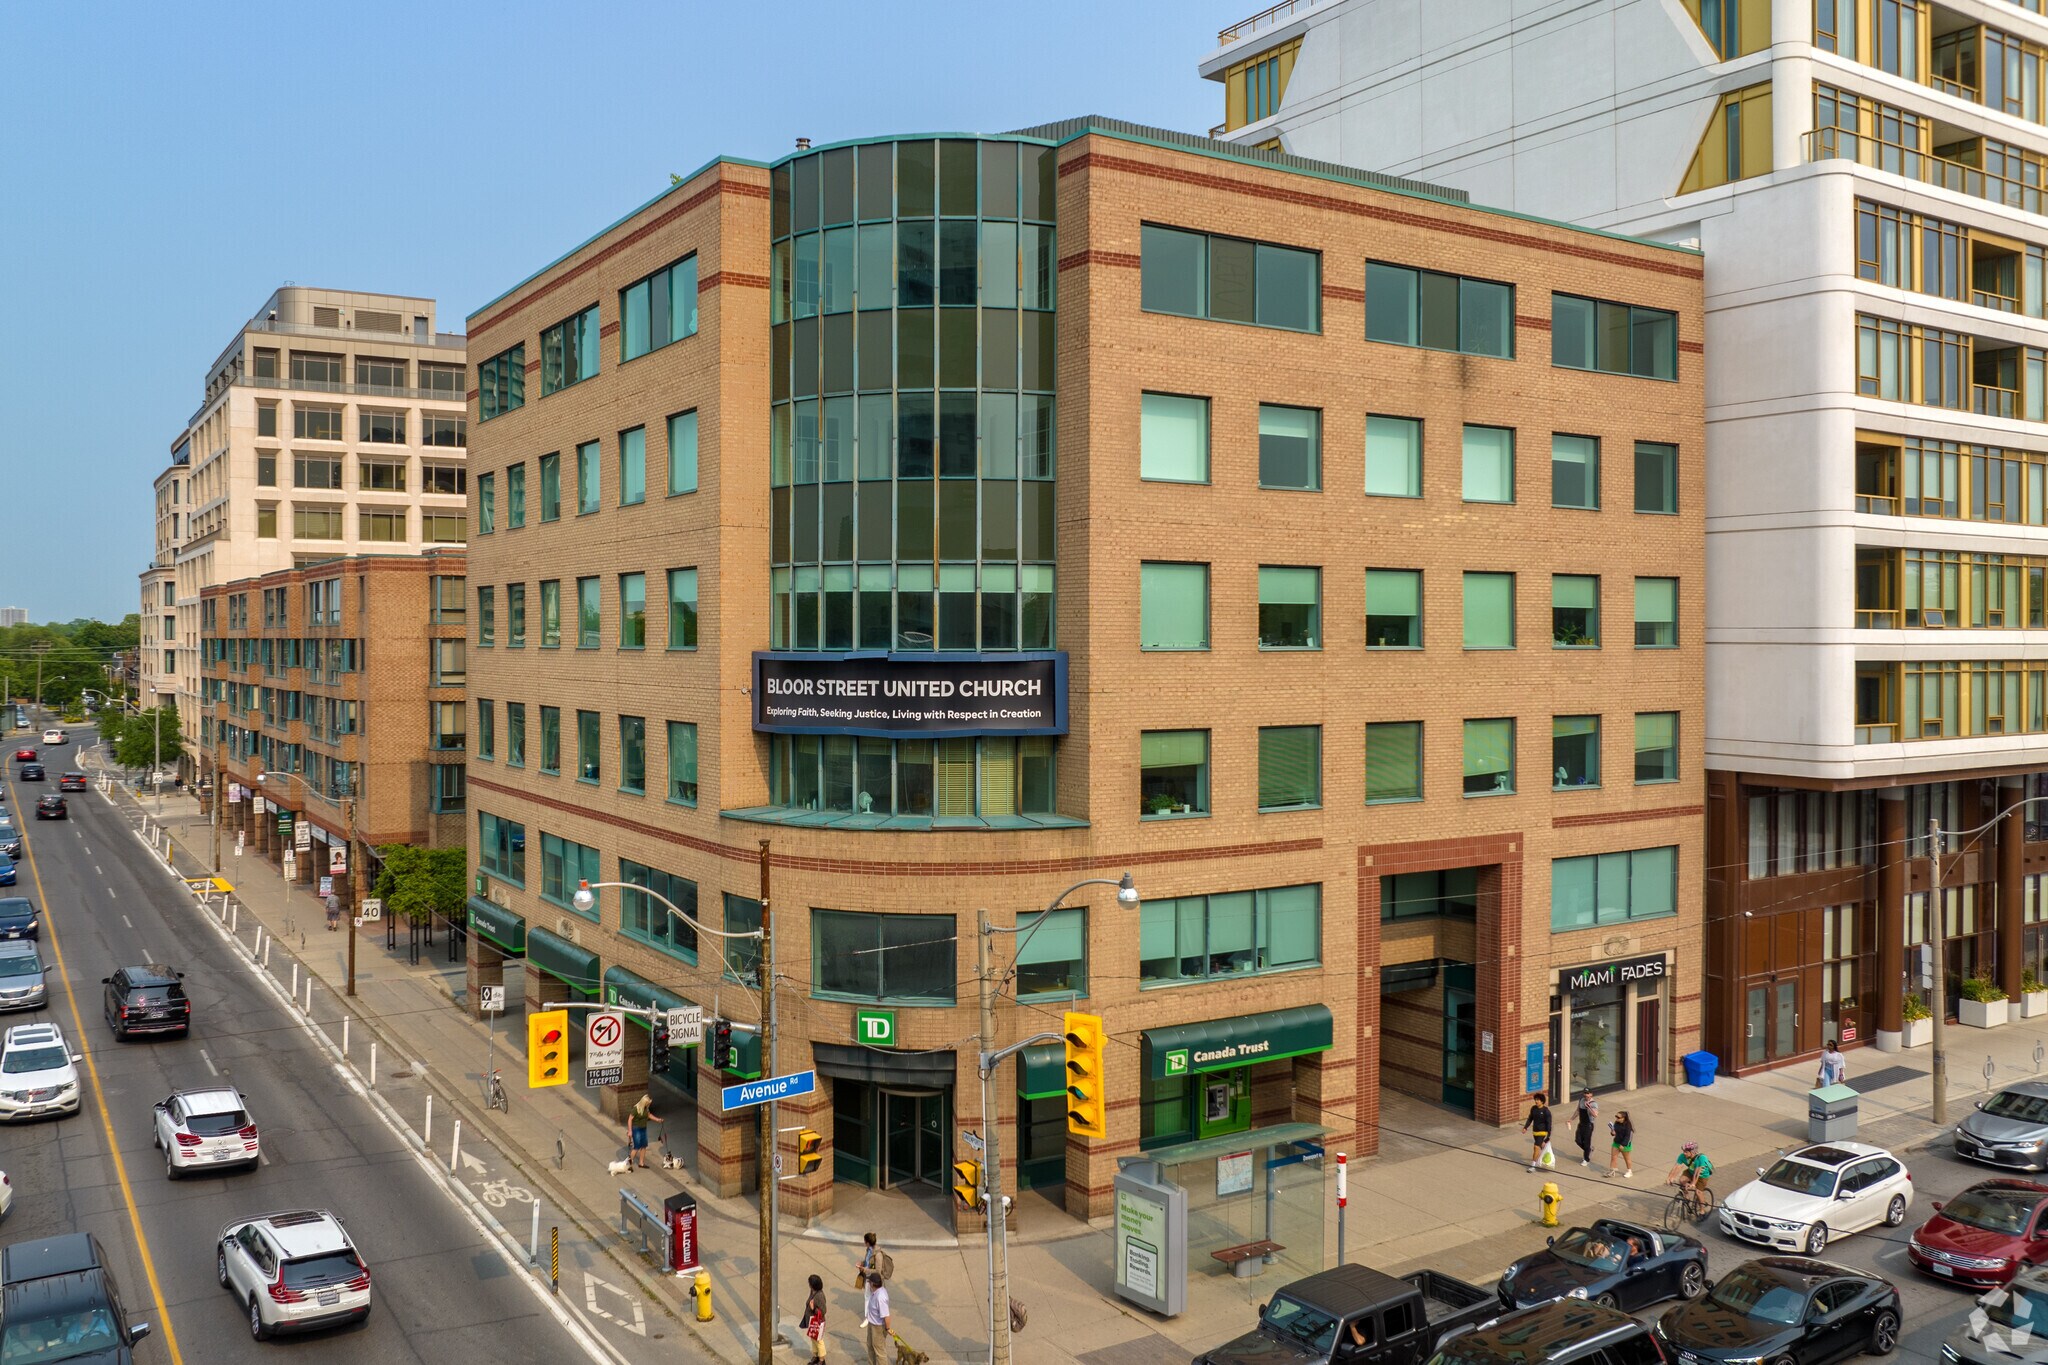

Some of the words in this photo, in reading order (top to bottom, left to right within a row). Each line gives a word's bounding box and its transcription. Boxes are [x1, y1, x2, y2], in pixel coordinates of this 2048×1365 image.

[767, 678, 813, 695] BLOOR
[816, 679, 880, 697] STREET
[883, 680, 955, 697] UNITED
[959, 679, 1042, 697] CHURCH
[766, 706, 797, 718] Exploring
[797, 707, 819, 718] Faith,
[820, 708, 852, 720] Seeking
[854, 708, 890, 720] Justice,
[892, 709, 922, 721] Living
[924, 709, 945, 719] with
[947, 709, 987, 721] Respect
[989, 709, 998, 718] in
[1000, 708, 1042, 718] Creation
[363, 907, 378, 917] 40
[1571, 967, 1614, 990] MIAMI
[1621, 961, 1663, 981] FADES
[670, 1012, 700, 1025] BICYCLE
[671, 1027, 699, 1040] SIGNAL
[861, 1017, 890, 1038] TD
[1168, 1054, 1186, 1071] TD
[1193, 1046, 1236, 1063] Canada
[1238, 1040, 1269, 1055] Trust
[601, 1068, 621, 1076] BUSES
[590, 1076, 620, 1085] EXCEPTED
[740, 1081, 787, 1101] Avenue
[789, 1076, 798, 1085] Rd
[1121, 1203, 1139, 1216] Make
[1139, 1211, 1153, 1221] your
[1121, 1213, 1142, 1226] money
[1121, 1222, 1143, 1235] moves.
[683, 1231, 691, 1263] FREE
